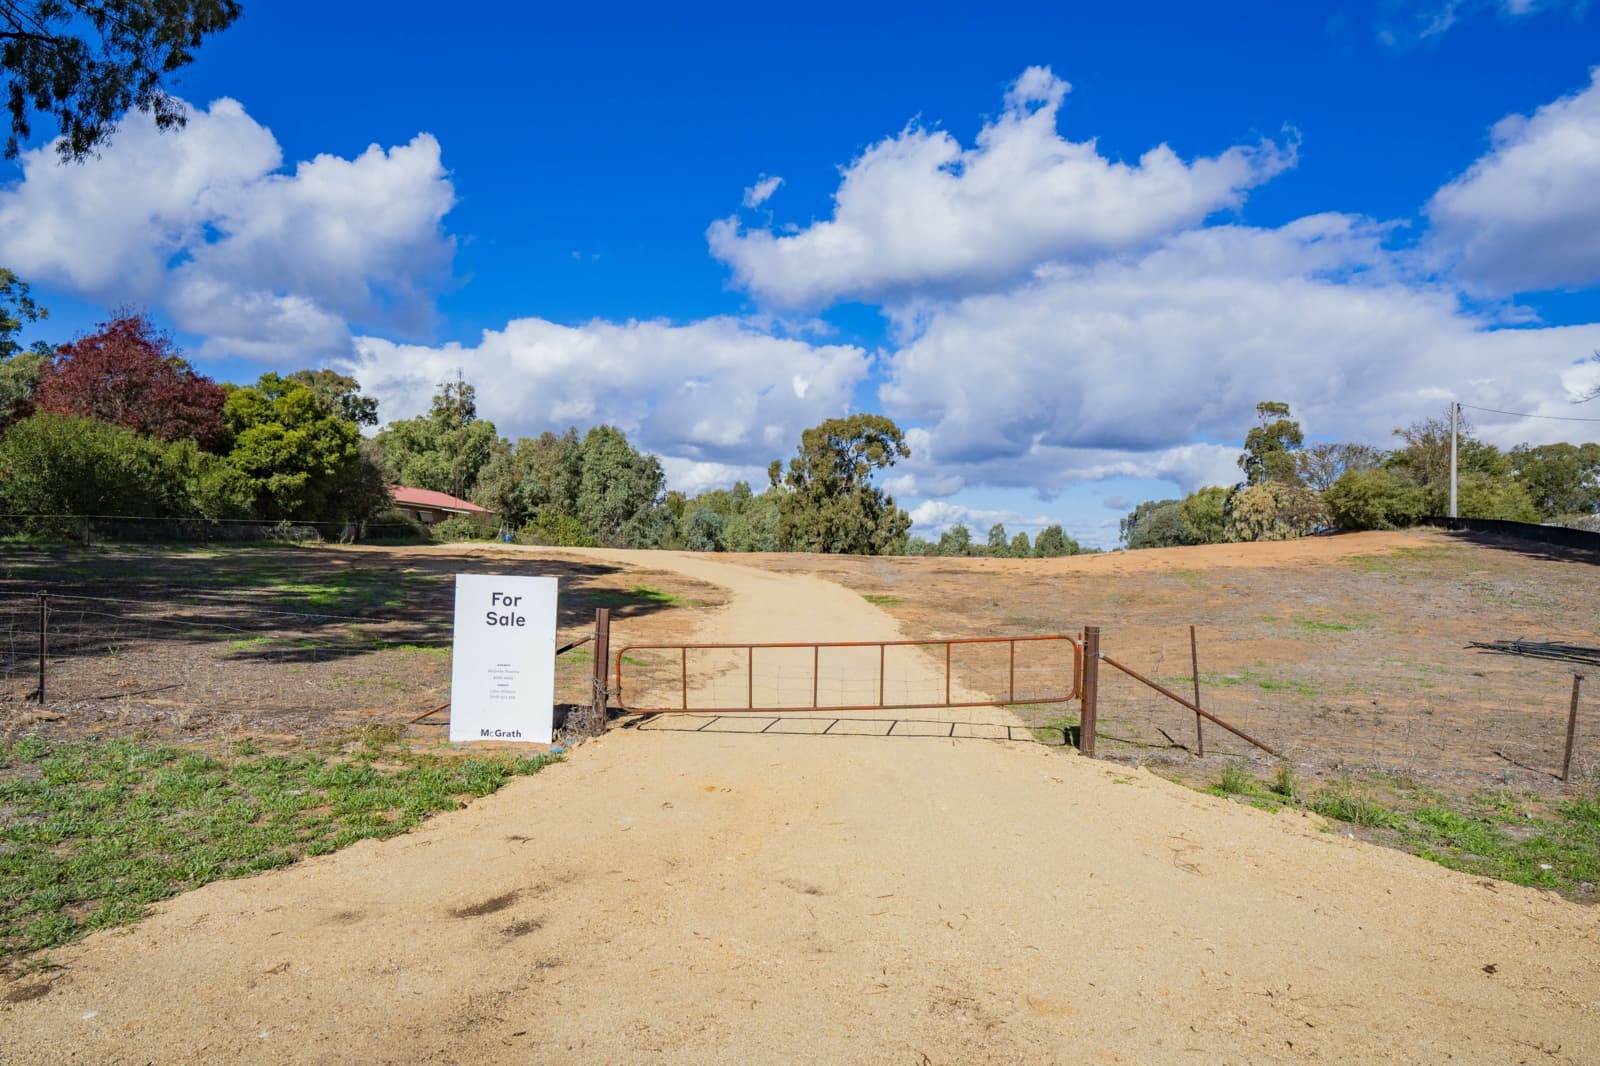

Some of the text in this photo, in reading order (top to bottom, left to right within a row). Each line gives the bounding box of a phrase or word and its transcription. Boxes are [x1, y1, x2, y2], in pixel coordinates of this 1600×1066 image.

[492, 592, 522, 607] For
[486, 611, 526, 627] Sale
[480, 729, 522, 738] McGrath
